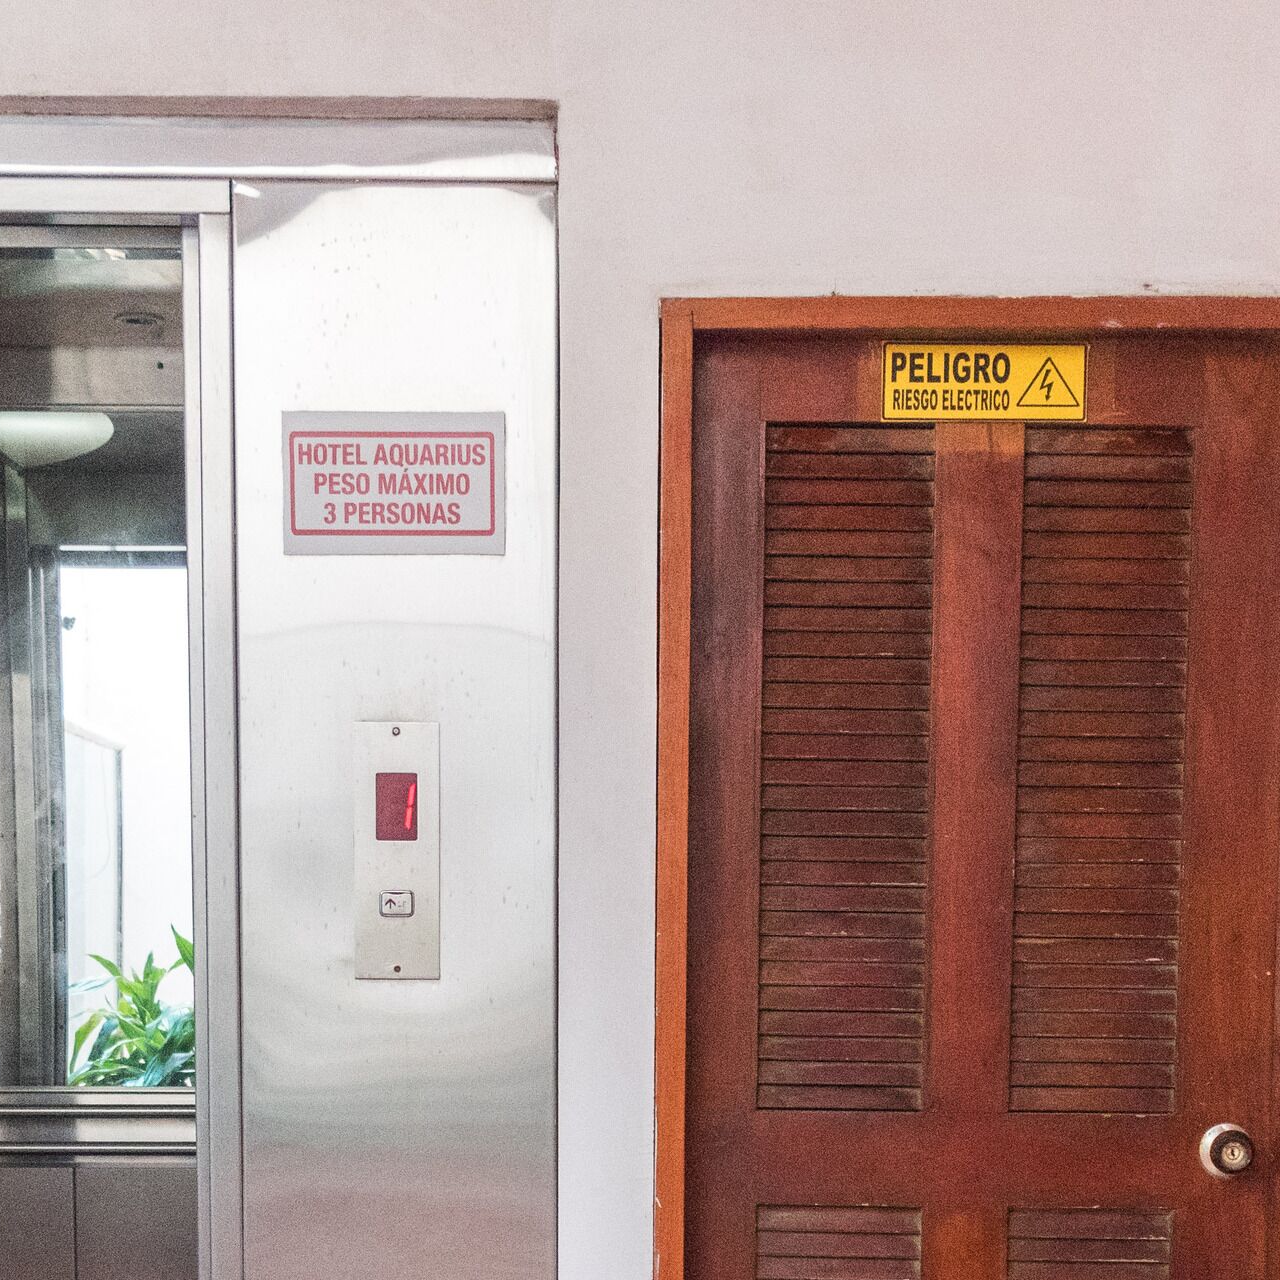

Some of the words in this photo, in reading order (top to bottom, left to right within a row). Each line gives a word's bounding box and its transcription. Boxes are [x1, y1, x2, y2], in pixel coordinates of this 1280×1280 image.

[891, 352, 1011, 384] PELIGRO
[892, 388, 939, 411] RIESGO
[942, 389, 1010, 411] ELECTRICO
[298, 443, 368, 466] HOTEL
[373, 443, 487, 467] AQUARIUS
[314, 472, 371, 496] PESO
[378, 468, 471, 496] MÁXIMO
[323, 502, 337, 525] 3
[344, 502, 461, 525] PERSONAS
[404, 783, 417, 831] 1
